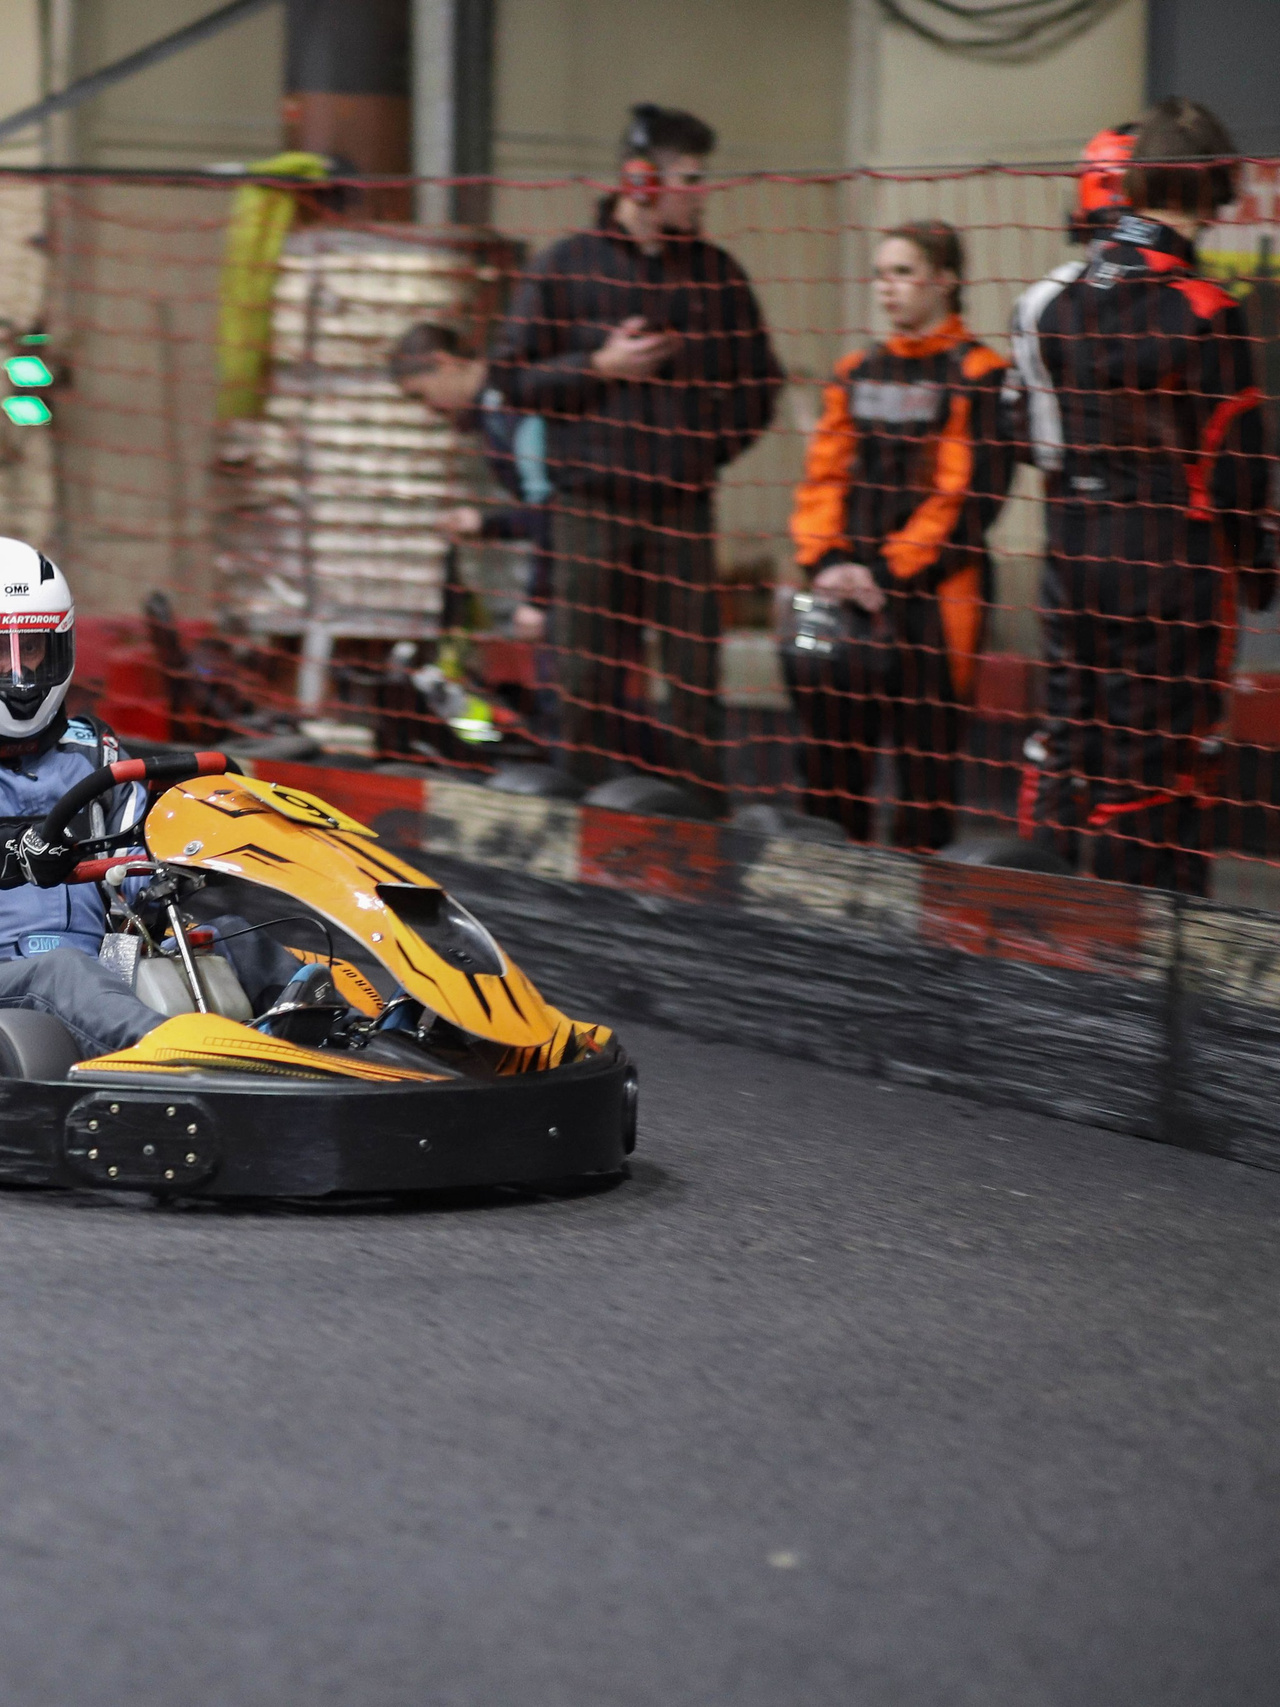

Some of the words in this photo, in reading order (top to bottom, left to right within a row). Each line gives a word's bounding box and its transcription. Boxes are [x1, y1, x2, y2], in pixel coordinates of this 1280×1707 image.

[5, 585, 29, 594] OMP
[2, 615, 61, 625] KARTDROME
[28, 937, 60, 951] OMP
